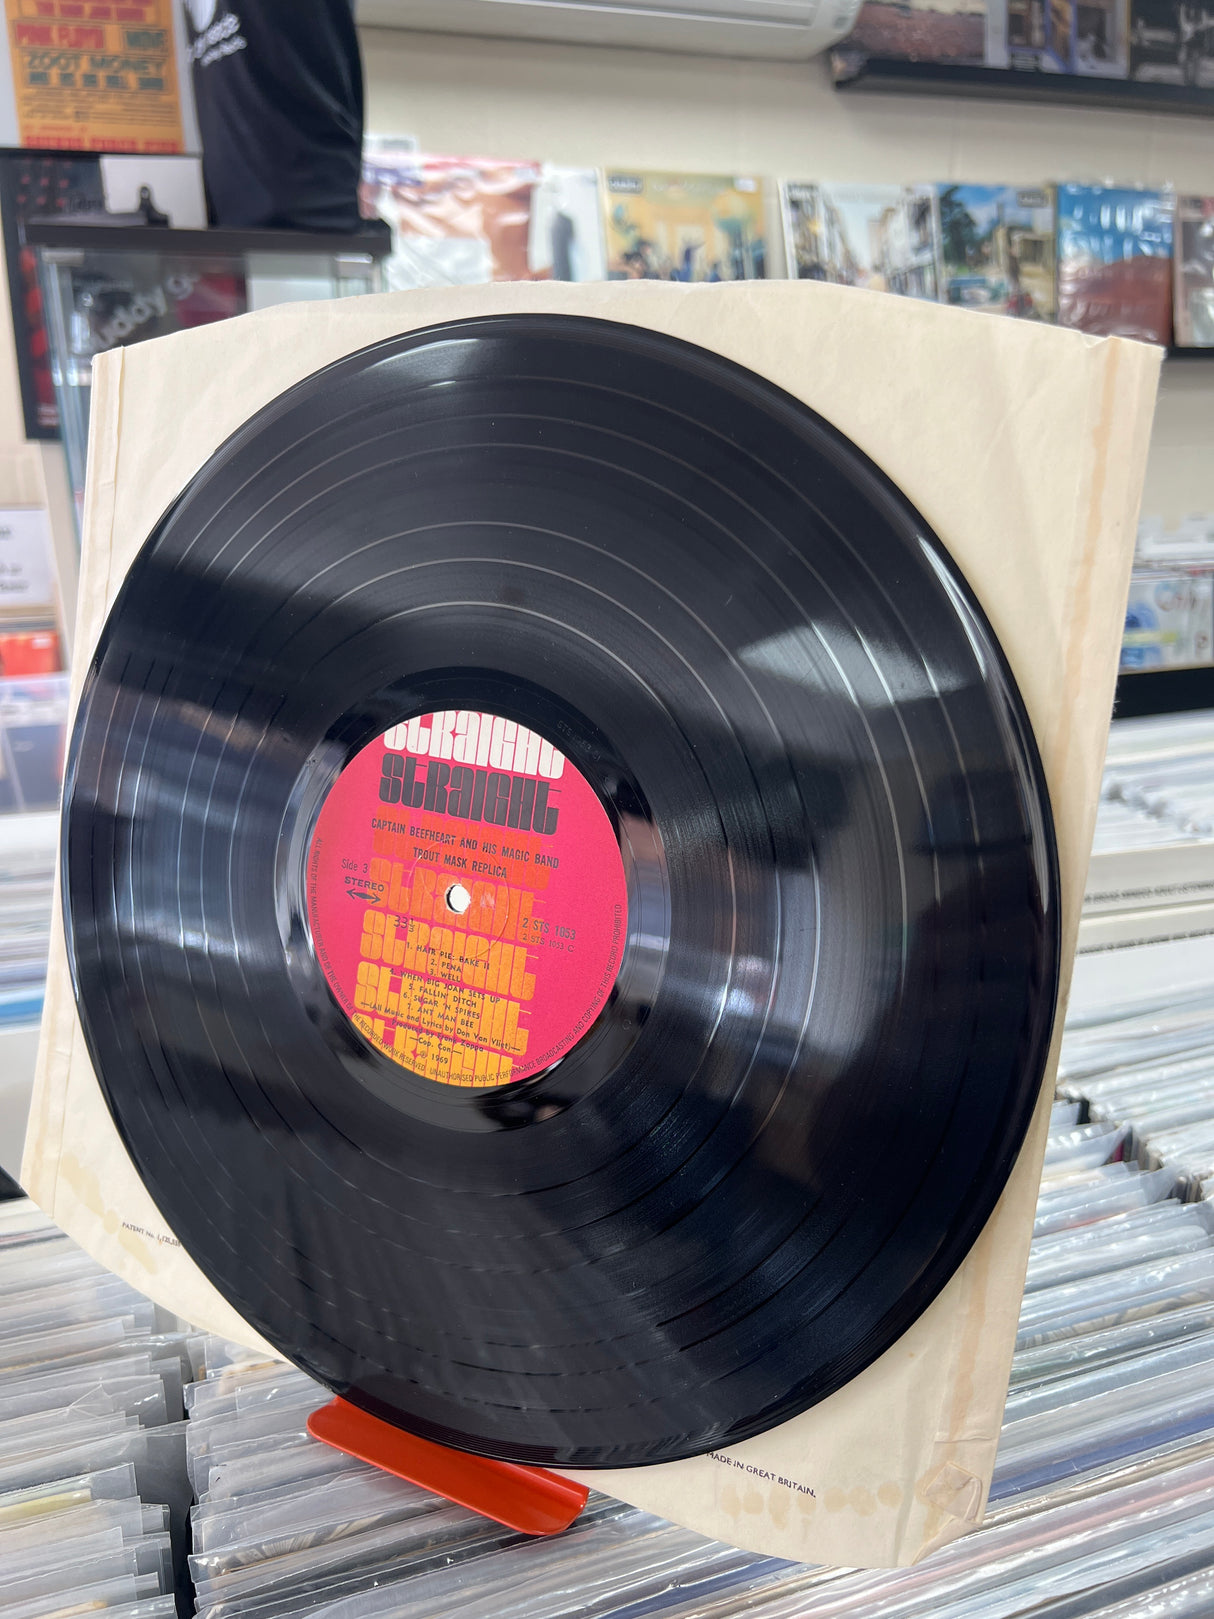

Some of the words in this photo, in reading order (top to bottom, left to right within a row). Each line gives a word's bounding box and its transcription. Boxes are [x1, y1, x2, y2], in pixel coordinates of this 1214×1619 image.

[315, 838, 323, 849] ALL
[371, 818, 405, 834] CAPTAIN
[409, 827, 455, 845] BEEFHEART
[460, 837, 477, 850] AND
[482, 843, 497, 855] HIS
[501, 846, 529, 862] MAGIC
[534, 854, 559, 869] BAND
[311, 851, 321, 873] RIGHTS
[341, 858, 358, 871] Side
[362, 863, 369, 874] 3
[413, 847, 439, 862] TROUT
[444, 855, 467, 869] MASK
[472, 861, 507, 878] REPLICA
[344, 876, 385, 892] STEREO
[310, 896, 324, 948] MANUFACTURER
[522, 918, 528, 928] 2
[533, 919, 550, 934] STS
[554, 925, 576, 940] 1053
[612, 904, 623, 945] PROHIBITED
[522, 933, 528, 941] 2
[530, 935, 545, 945] STS
[567, 944, 575, 953] C
[416, 945, 436, 956] HAIR
[440, 950, 455, 961] PIE:
[459, 955, 479, 968] BAKE
[441, 961, 462, 973] PENA
[606, 946, 619, 973] RECORD
[328, 970, 337, 981] THE
[390, 968, 397, 976] 4.
[400, 971, 423, 982] WHEN
[426, 978, 440, 988] BIG
[444, 982, 464, 994] JOAN
[468, 989, 485, 1001] SETS
[490, 996, 500, 1004] UP
[440, 971, 461, 983] WELL
[600, 971, 612, 988] THIS
[333, 982, 350, 1004] OWNER
[409, 983, 415, 991] 5.
[453, 995, 477, 1008] DITCH
[596, 988, 605, 998] OF
[403, 991, 410, 999] 6.
[413, 994, 439, 1008] SUGAR
[455, 1006, 480, 1020] SPIKES
[582, 997, 601, 1024] COPYING
[384, 1007, 404, 1018] Music
[406, 1014, 420, 1023] and
[422, 1017, 443, 1030] Lyrics
[444, 1023, 454, 1034] by
[456, 1028, 470, 1038] Don
[473, 1033, 488, 1043] Van
[417, 1007, 434, 1017] ANT
[437, 1011, 456, 1022] MAN
[461, 1019, 474, 1029] BEE
[572, 1021, 585, 1037] AND
[360, 1020, 383, 1045] RECORDED
[392, 1019, 423, 1033] Produced
[425, 1029, 434, 1038] by
[437, 1032, 457, 1044] Frank
[460, 1039, 484, 1052] Zappa
[383, 1042, 399, 1058] WORK
[431, 1054, 449, 1064] 1969
[535, 1032, 575, 1066] BROADCASTING
[398, 1053, 425, 1071] RESERVED
[496, 1063, 537, 1080] PERFORMANCE
[429, 1067, 473, 1082] UNAUTHORISED
[474, 1073, 495, 1082] PUBLIC
[122, 1222, 145, 1234] PATENT
[706, 1451, 732, 1466] MADE
[733, 1460, 744, 1470] IN
[746, 1465, 776, 1481] GREAT
[777, 1476, 816, 1498] BRITAIN.
